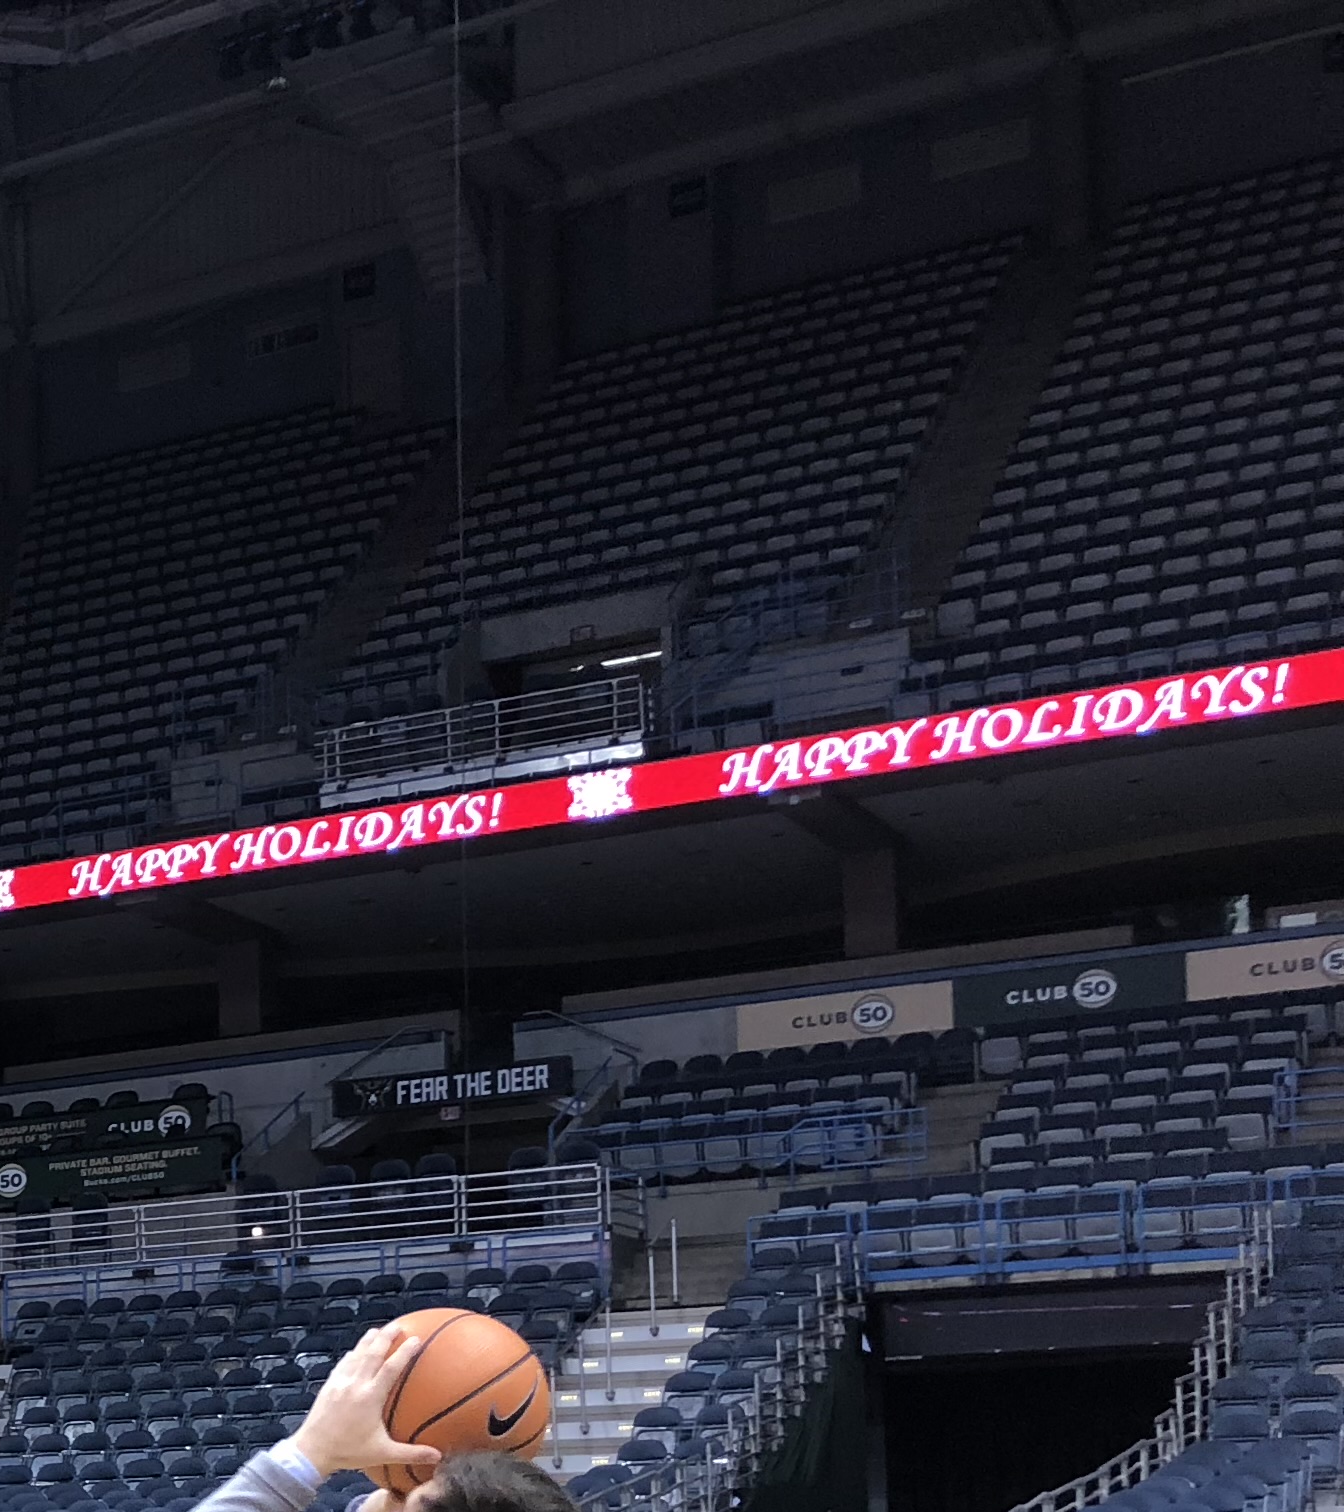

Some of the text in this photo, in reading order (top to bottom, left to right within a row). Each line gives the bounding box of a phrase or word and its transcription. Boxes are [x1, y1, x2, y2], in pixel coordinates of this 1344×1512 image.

[718, 663, 1290, 794] HAPPY HOLIDAYS!
[68, 793, 503, 897] HAPPY HOLIDAYS!
[1250, 956, 1316, 977] CLUB
[1006, 979, 1110, 1005] CLUB 50
[791, 1005, 888, 1029] CLUB 50
[396, 1064, 549, 1105] FEAR THE DEER
[0, 1172, 23, 1189] 50
